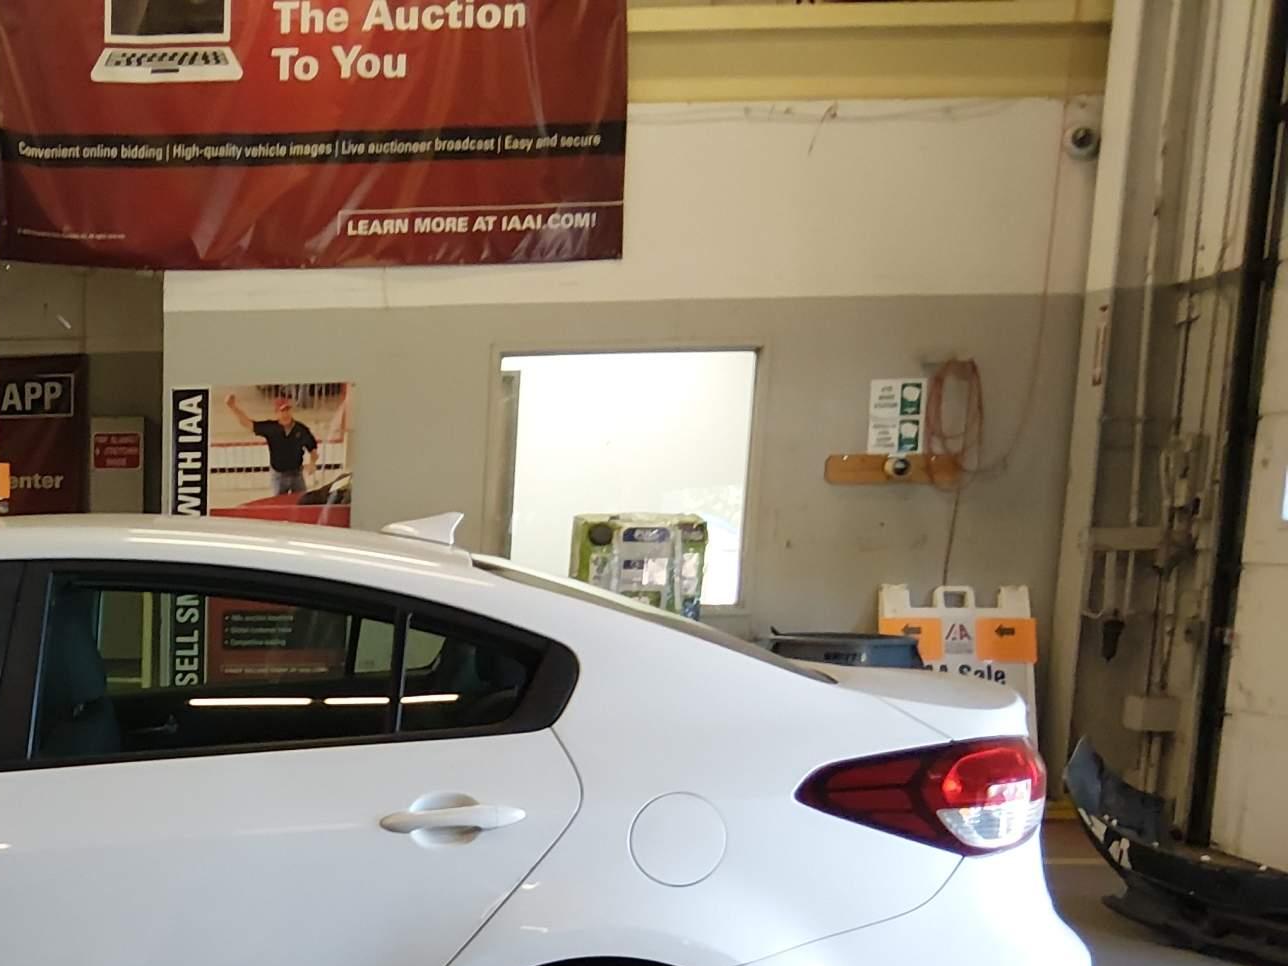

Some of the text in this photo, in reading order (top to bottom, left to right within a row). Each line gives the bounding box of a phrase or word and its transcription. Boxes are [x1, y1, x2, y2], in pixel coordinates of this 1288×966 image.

[272, 0, 527, 34] The Auction
[271, 45, 408, 81] To You
[18, 140, 80, 160] Convenient
[82, 145, 117, 160] online
[120, 144, 163, 162] bidding
[173, 143, 243, 161] High-quality
[245, 143, 287, 159] vehicle
[289, 142, 332, 159] images
[341, 140, 365, 155] Live
[368, 139, 432, 155] auctioneer
[434, 136, 495, 152] broadcast
[505, 135, 533, 153] Easy
[536, 133, 558, 149] and
[560, 133, 601, 149] secure
[347, 212, 598, 236] LEARN MORE AT IAAI.COM!
[1, 381, 63, 411] APP
[177, 394, 203, 517] WITH IAA
[175, 629, 200, 686] SELL
